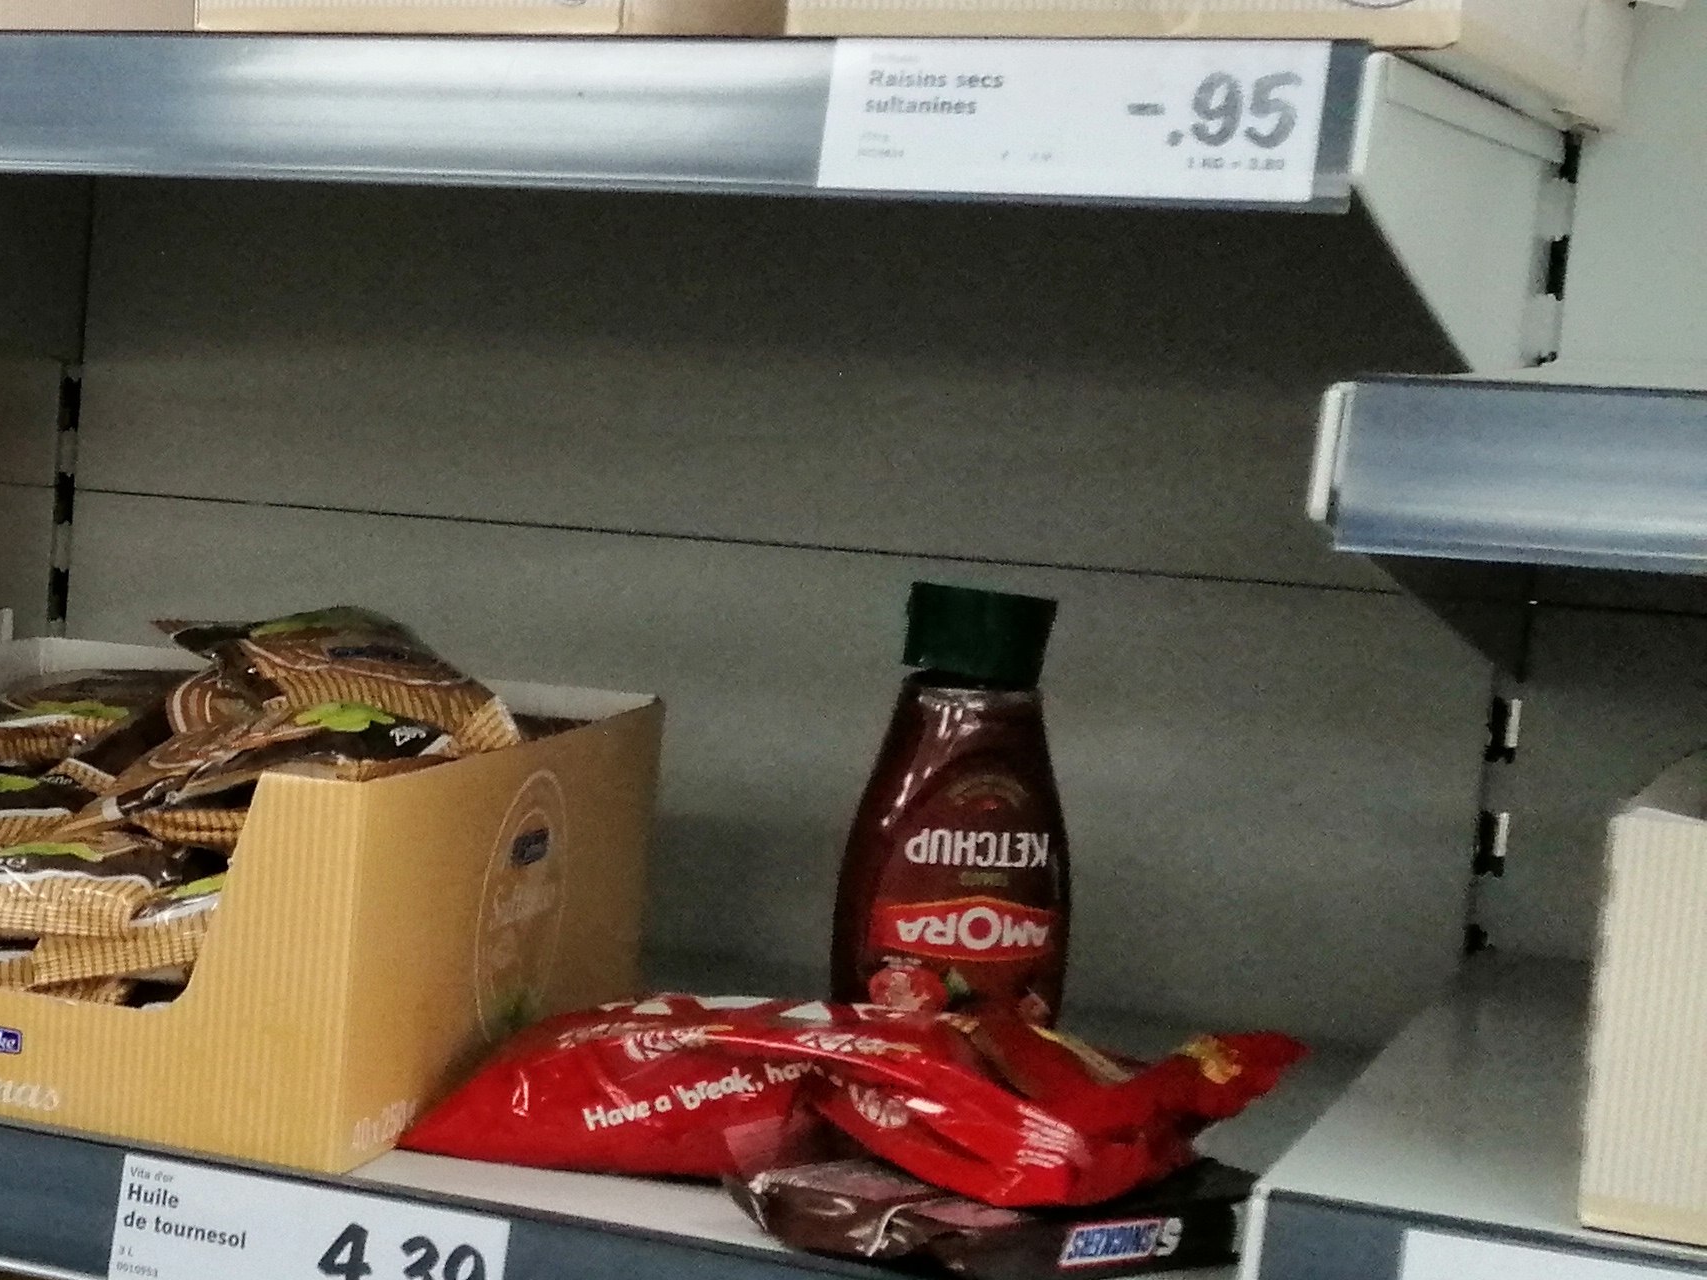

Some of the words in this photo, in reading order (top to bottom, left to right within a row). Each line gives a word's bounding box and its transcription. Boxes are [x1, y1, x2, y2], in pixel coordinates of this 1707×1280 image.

[869, 70, 947, 88] Raisins
[956, 74, 1004, 88] secs
[865, 95, 978, 115] sultanines
[1128, 71, 1303, 147] -.95
[904, 828, 1050, 868] KETCHUP
[896, 907, 1051, 950] AMORA
[582, 1100, 650, 1132] Have
[654, 1095, 672, 1113] a
[129, 1166, 151, 1181] Vita
[153, 1170, 174, 1184] d'or
[127, 1183, 180, 1209] Huile
[124, 1211, 147, 1231] de
[154, 1218, 246, 1250] tournesol
